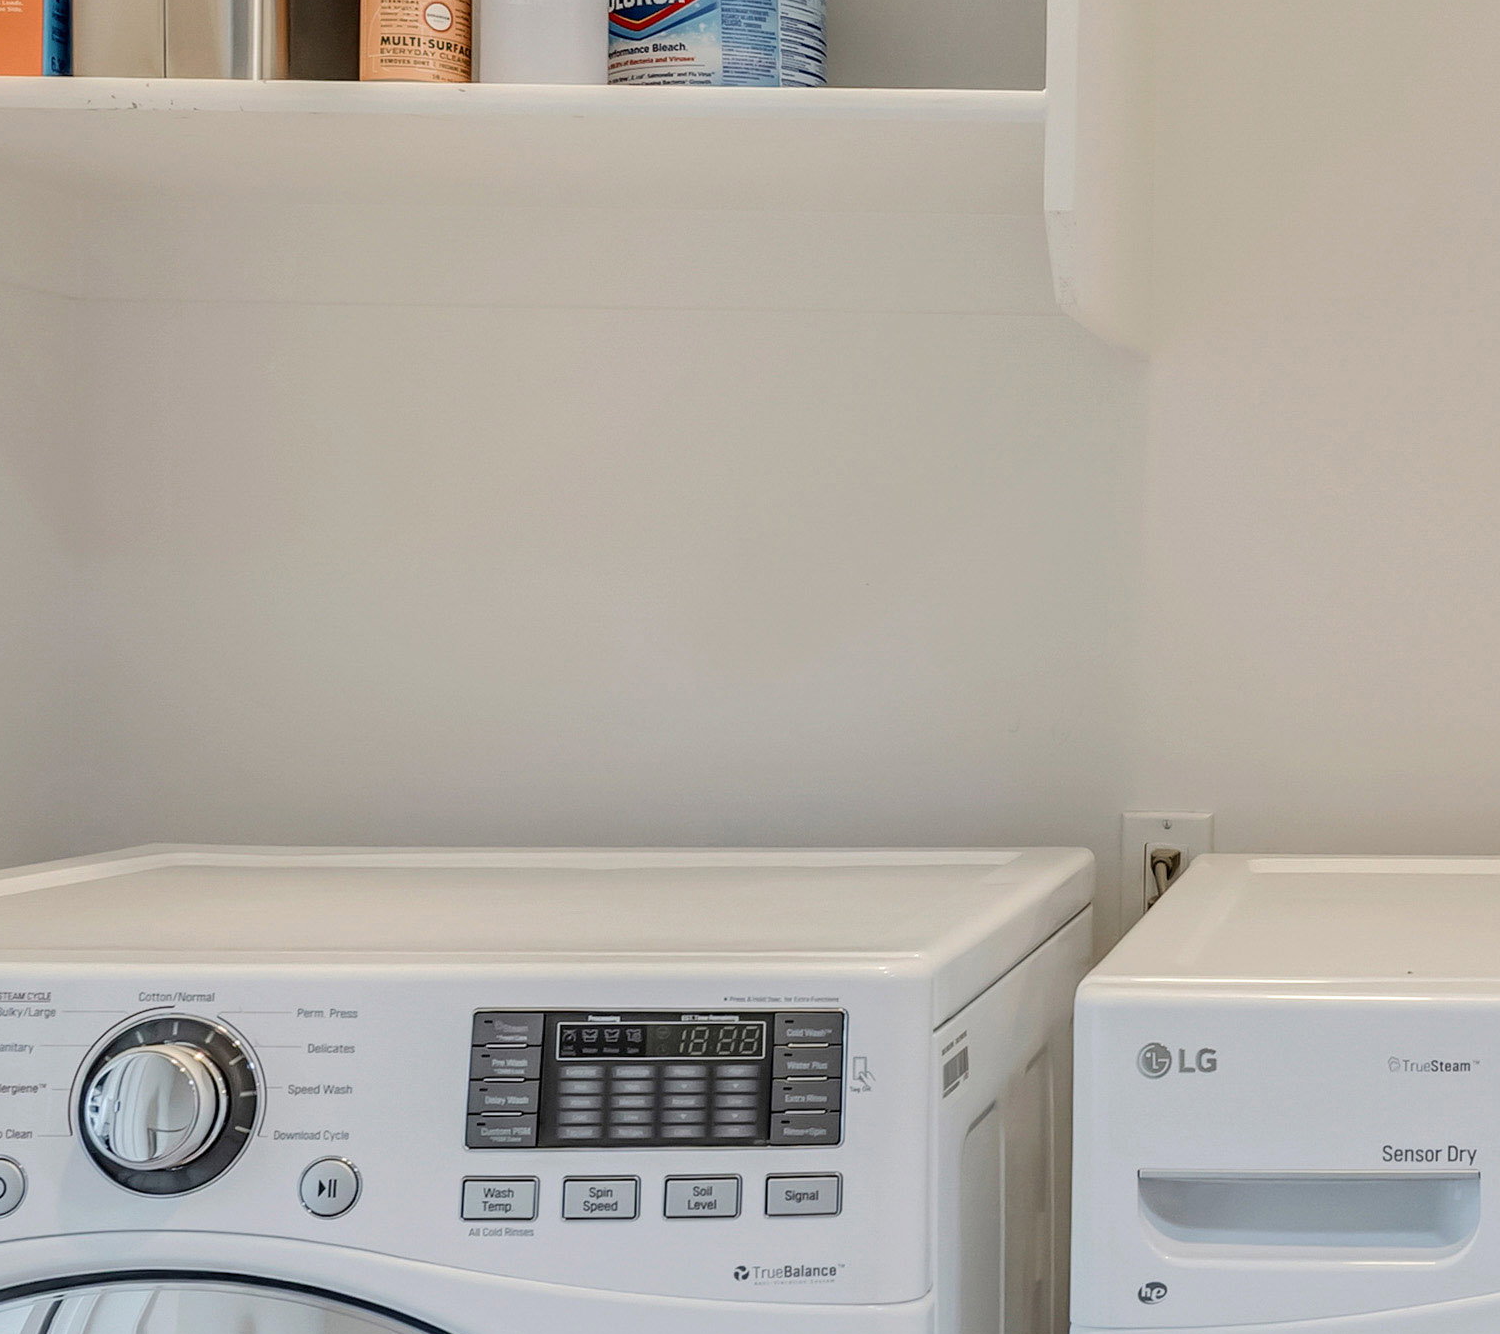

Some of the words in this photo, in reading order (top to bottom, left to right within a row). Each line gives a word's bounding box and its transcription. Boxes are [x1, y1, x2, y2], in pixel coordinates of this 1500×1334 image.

[380, 47, 437, 58] EVERYDAY
[652, 42, 686, 53] Bleach
[27, 992, 51, 1001] CYCLE
[138, 992, 216, 1002] Cotton/Normal
[329, 1008, 358, 1018] Press
[307, 1044, 355, 1054] Delicates
[1179, 1048, 1217, 1073] LG
[288, 1085, 320, 1095] Speed
[323, 1084, 353, 1095] Wash
[5, 1128, 33, 1139] Clean
[273, 1130, 320, 1140] Download
[323, 1131, 350, 1142] Cycle
[1382, 1145, 1442, 1162] Sensor
[1448, 1145, 1477, 1166] Dry
[484, 1187, 514, 1198] Wash
[589, 1187, 613, 1198] Spin
[692, 1186, 713, 1197] Soil
[785, 1190, 819, 1203] Signal
[583, 1200, 618, 1213] Speed
[687, 1199, 717, 1210] Level
[468, 1228, 480, 1237] All
[482, 1227, 502, 1237] Cold
[504, 1227, 535, 1237] Rinses
